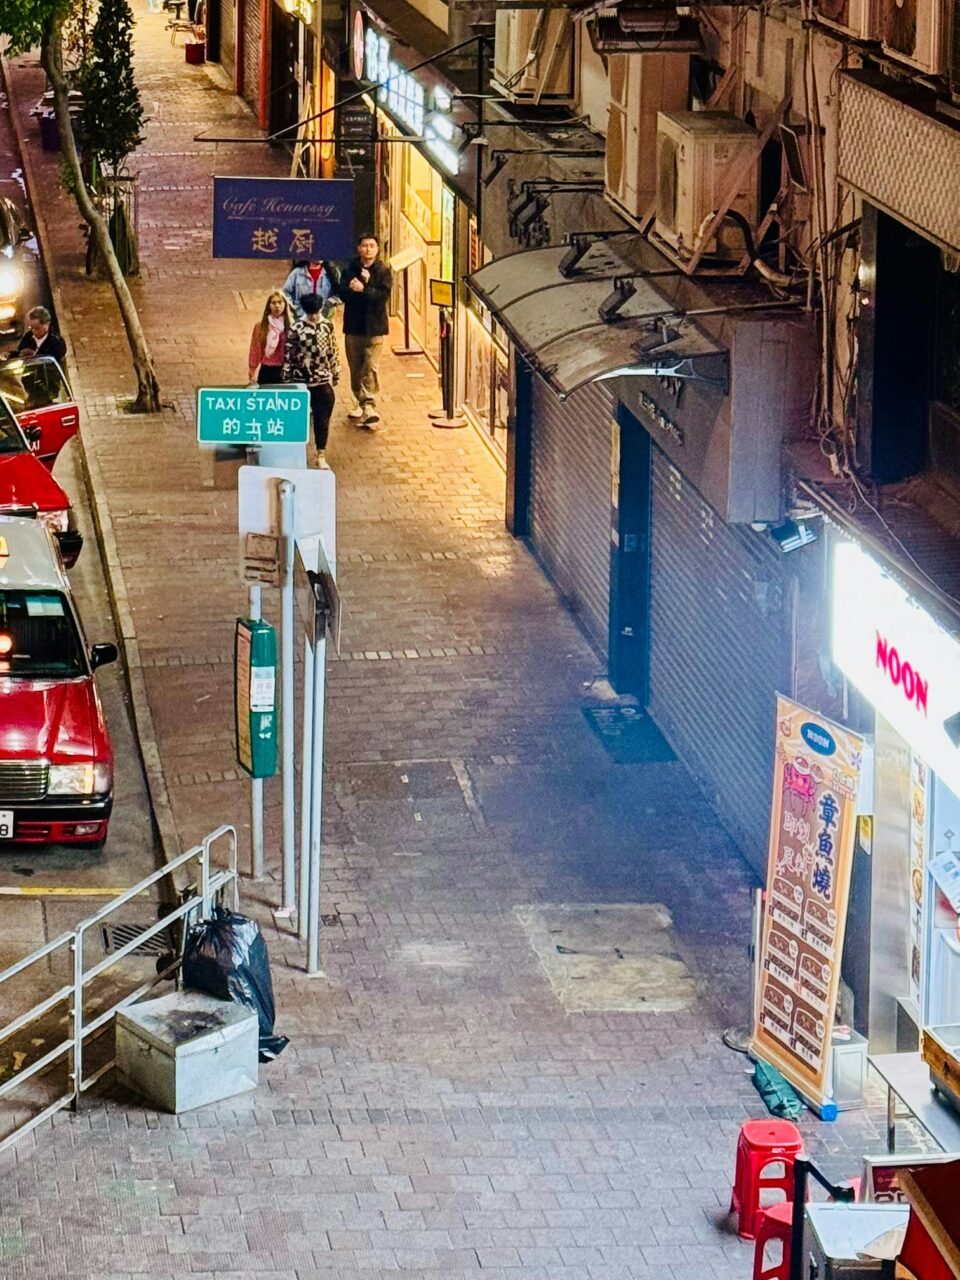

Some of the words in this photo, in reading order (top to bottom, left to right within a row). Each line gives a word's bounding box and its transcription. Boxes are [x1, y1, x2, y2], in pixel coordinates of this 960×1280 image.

[260, 197, 336, 218] Hennessy
[206, 396, 241, 411] TAXI
[246, 397, 302, 412] STAND
[222, 416, 285, 437] 的士站
[875, 629, 929, 718] NOON
[806, 728, 831, 750] NOON
[811, 792, 841, 903] 章魚燒
